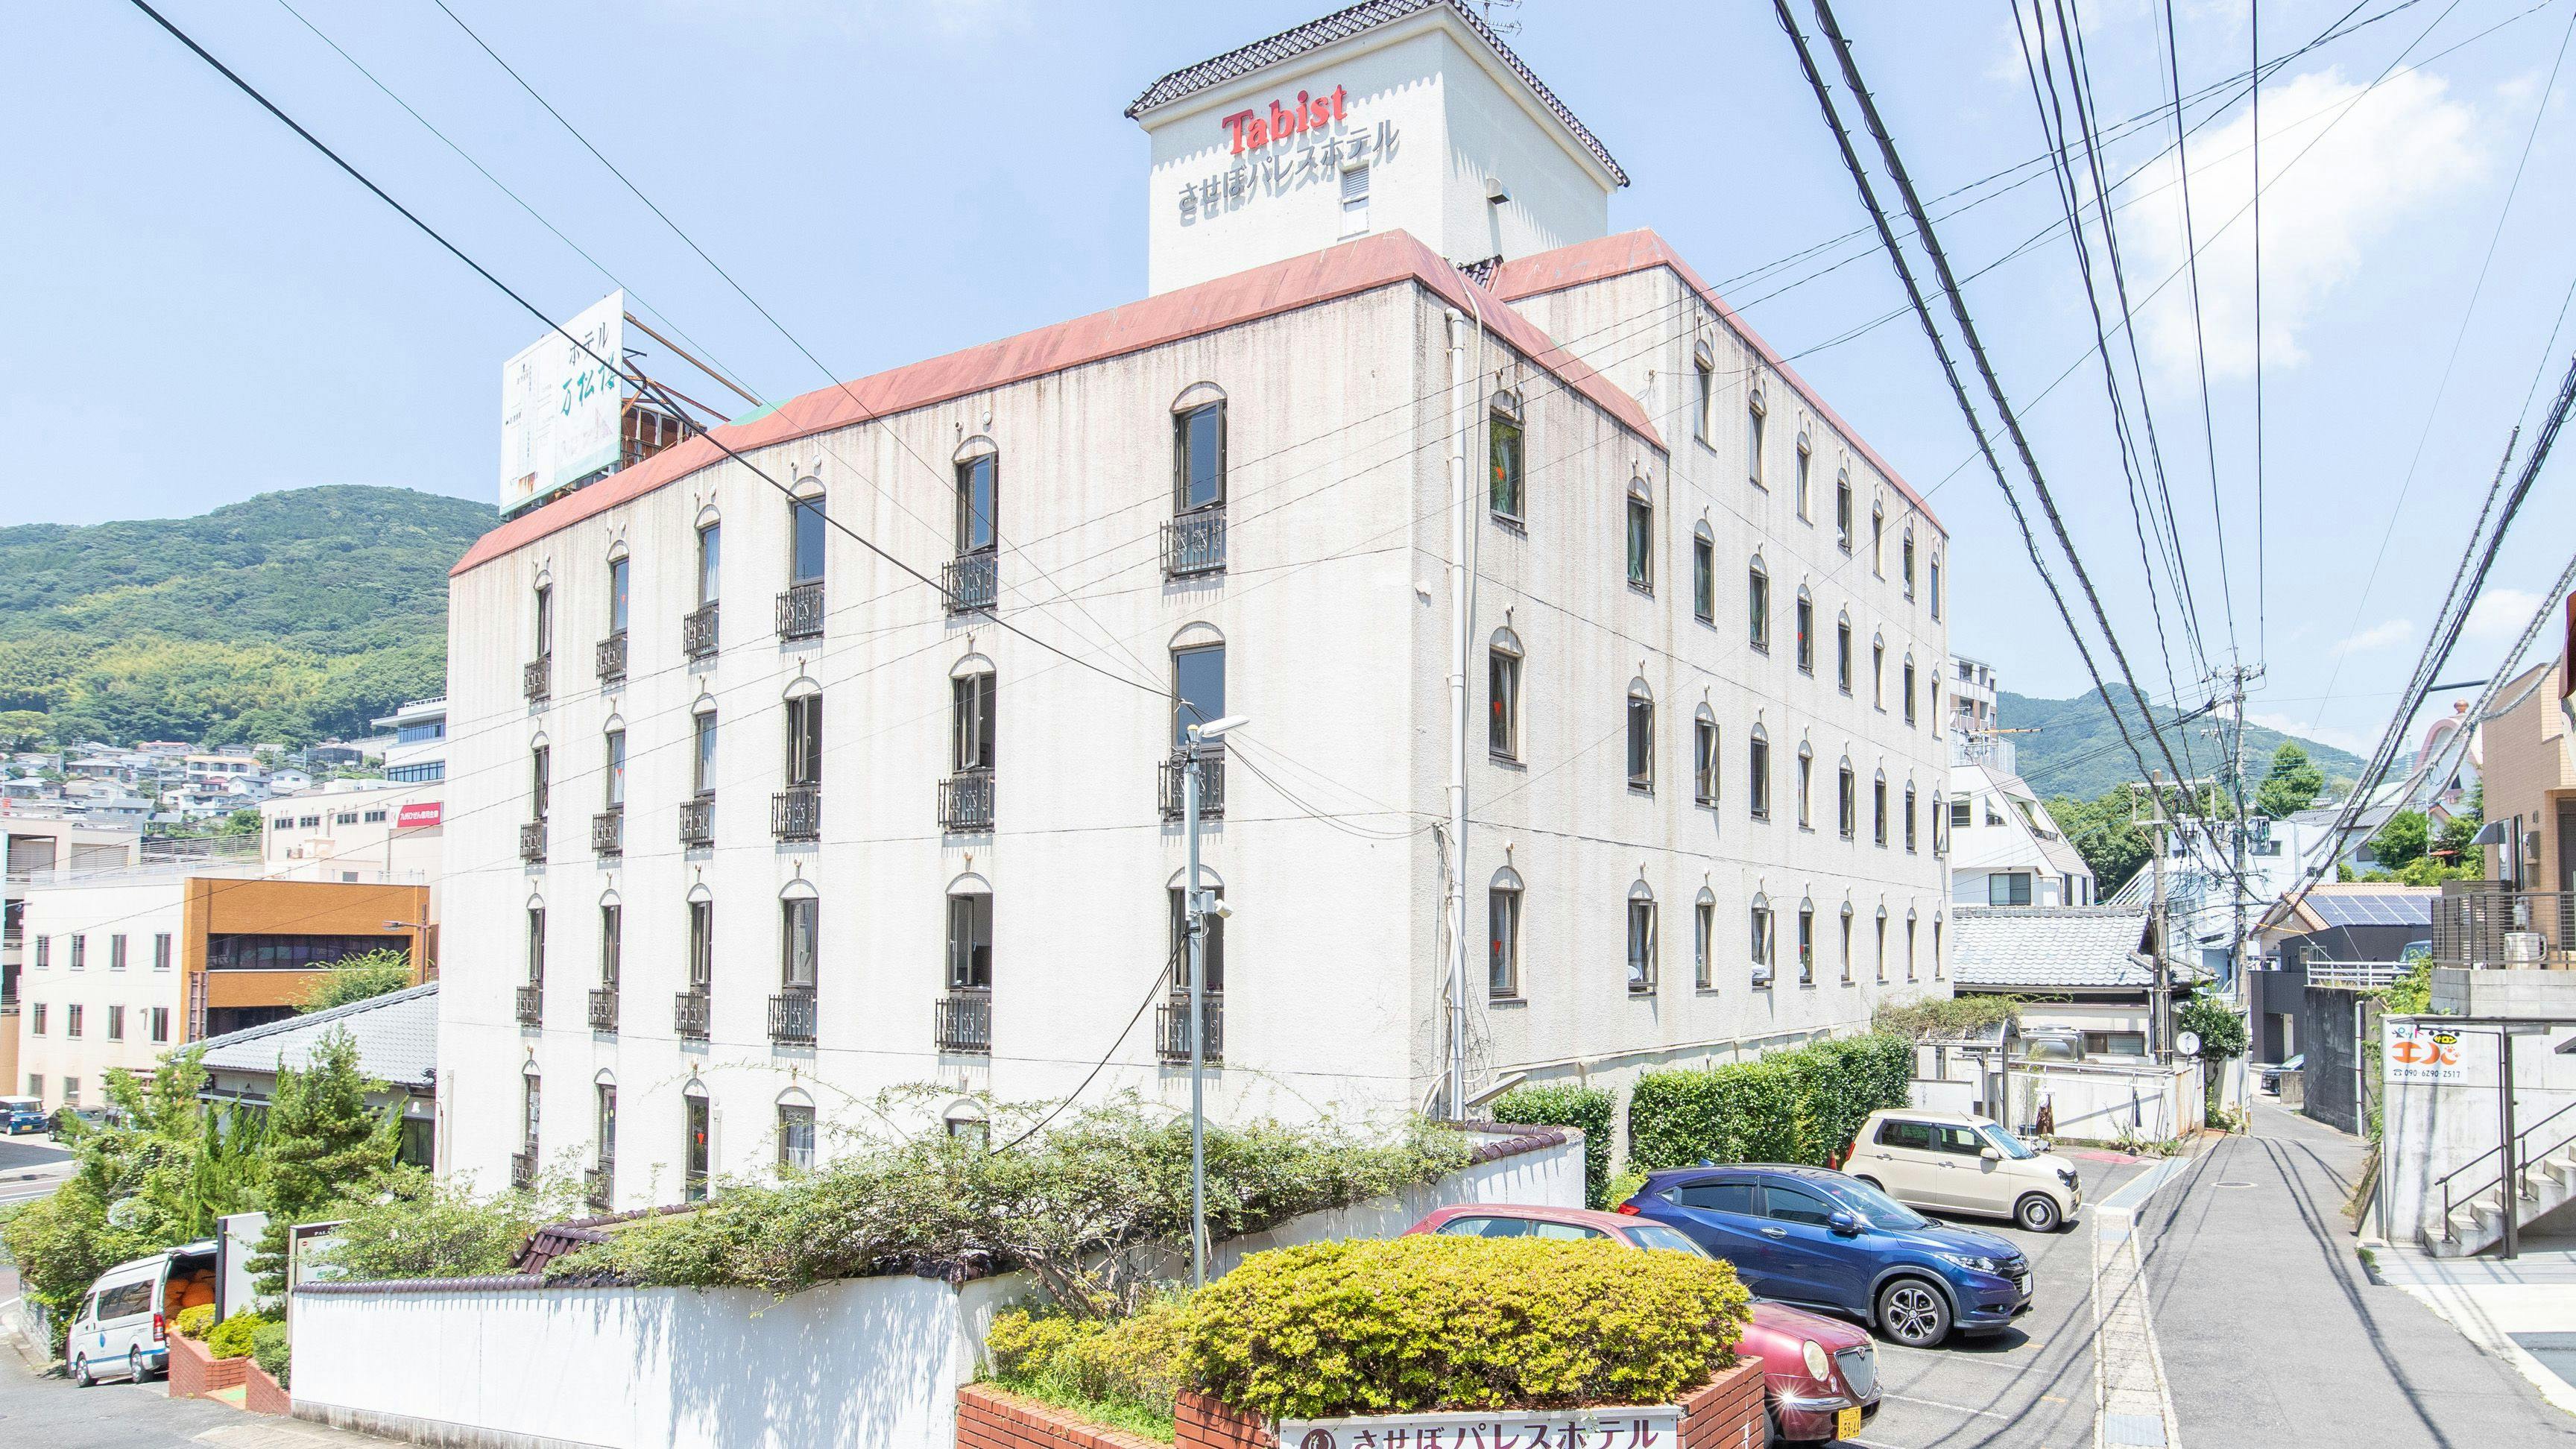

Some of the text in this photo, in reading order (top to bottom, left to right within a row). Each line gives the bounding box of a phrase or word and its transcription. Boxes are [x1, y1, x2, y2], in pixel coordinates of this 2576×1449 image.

[1222, 83, 1348, 155] Tabist
[1178, 119, 1400, 212] させぼパレスホテル
[569, 322, 609, 366] ホテル
[2434, 1035, 2457, 1044] サロン
